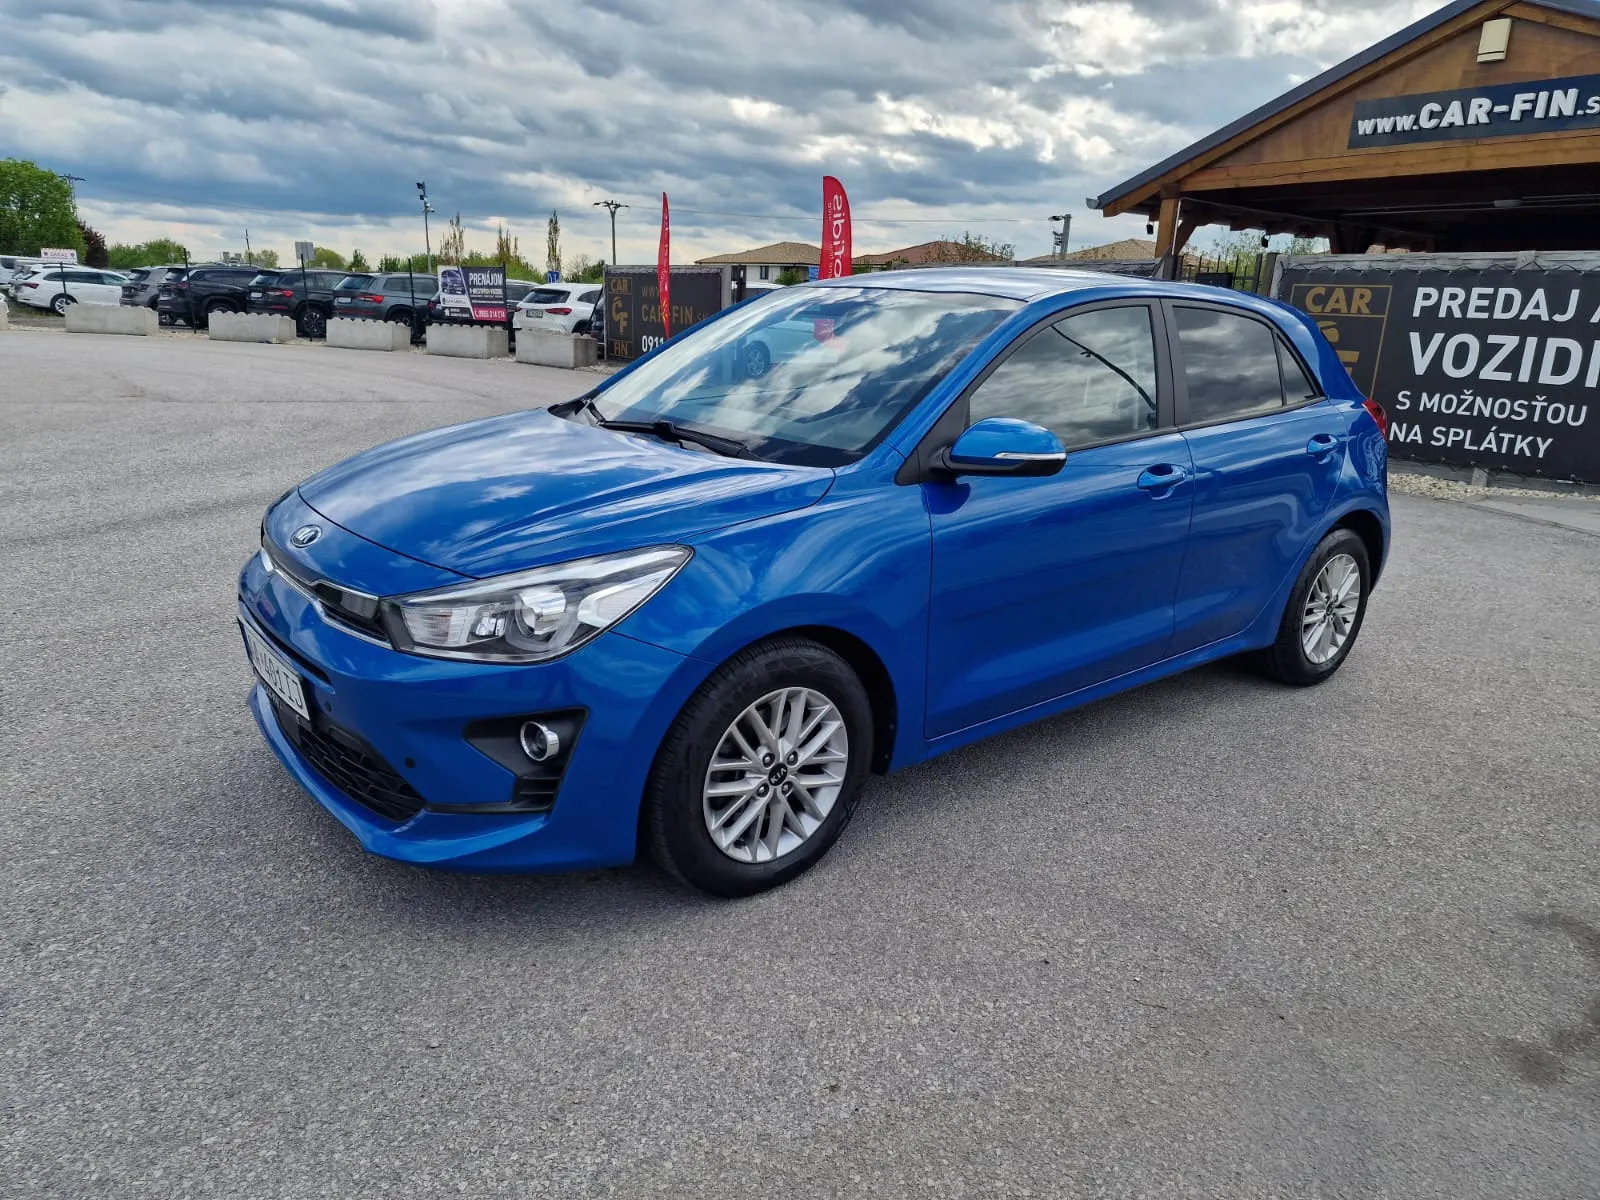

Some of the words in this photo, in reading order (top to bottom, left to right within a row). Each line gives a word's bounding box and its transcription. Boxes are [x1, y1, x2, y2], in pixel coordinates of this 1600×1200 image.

[469, 270, 503, 286] PRENÁJOM
[610, 279, 628, 293] CAR
[1305, 286, 1372, 314] CAR
[1412, 286, 1580, 322] PREDAJ
[614, 341, 628, 355] FIN
[1395, 390, 1412, 411] S
[1418, 389, 1588, 427] MOŽNOSŤOU
[1389, 421, 1423, 444] NA
[1430, 425, 1553, 459] SPLÁTKY
[770, 767, 787, 784] KIA
